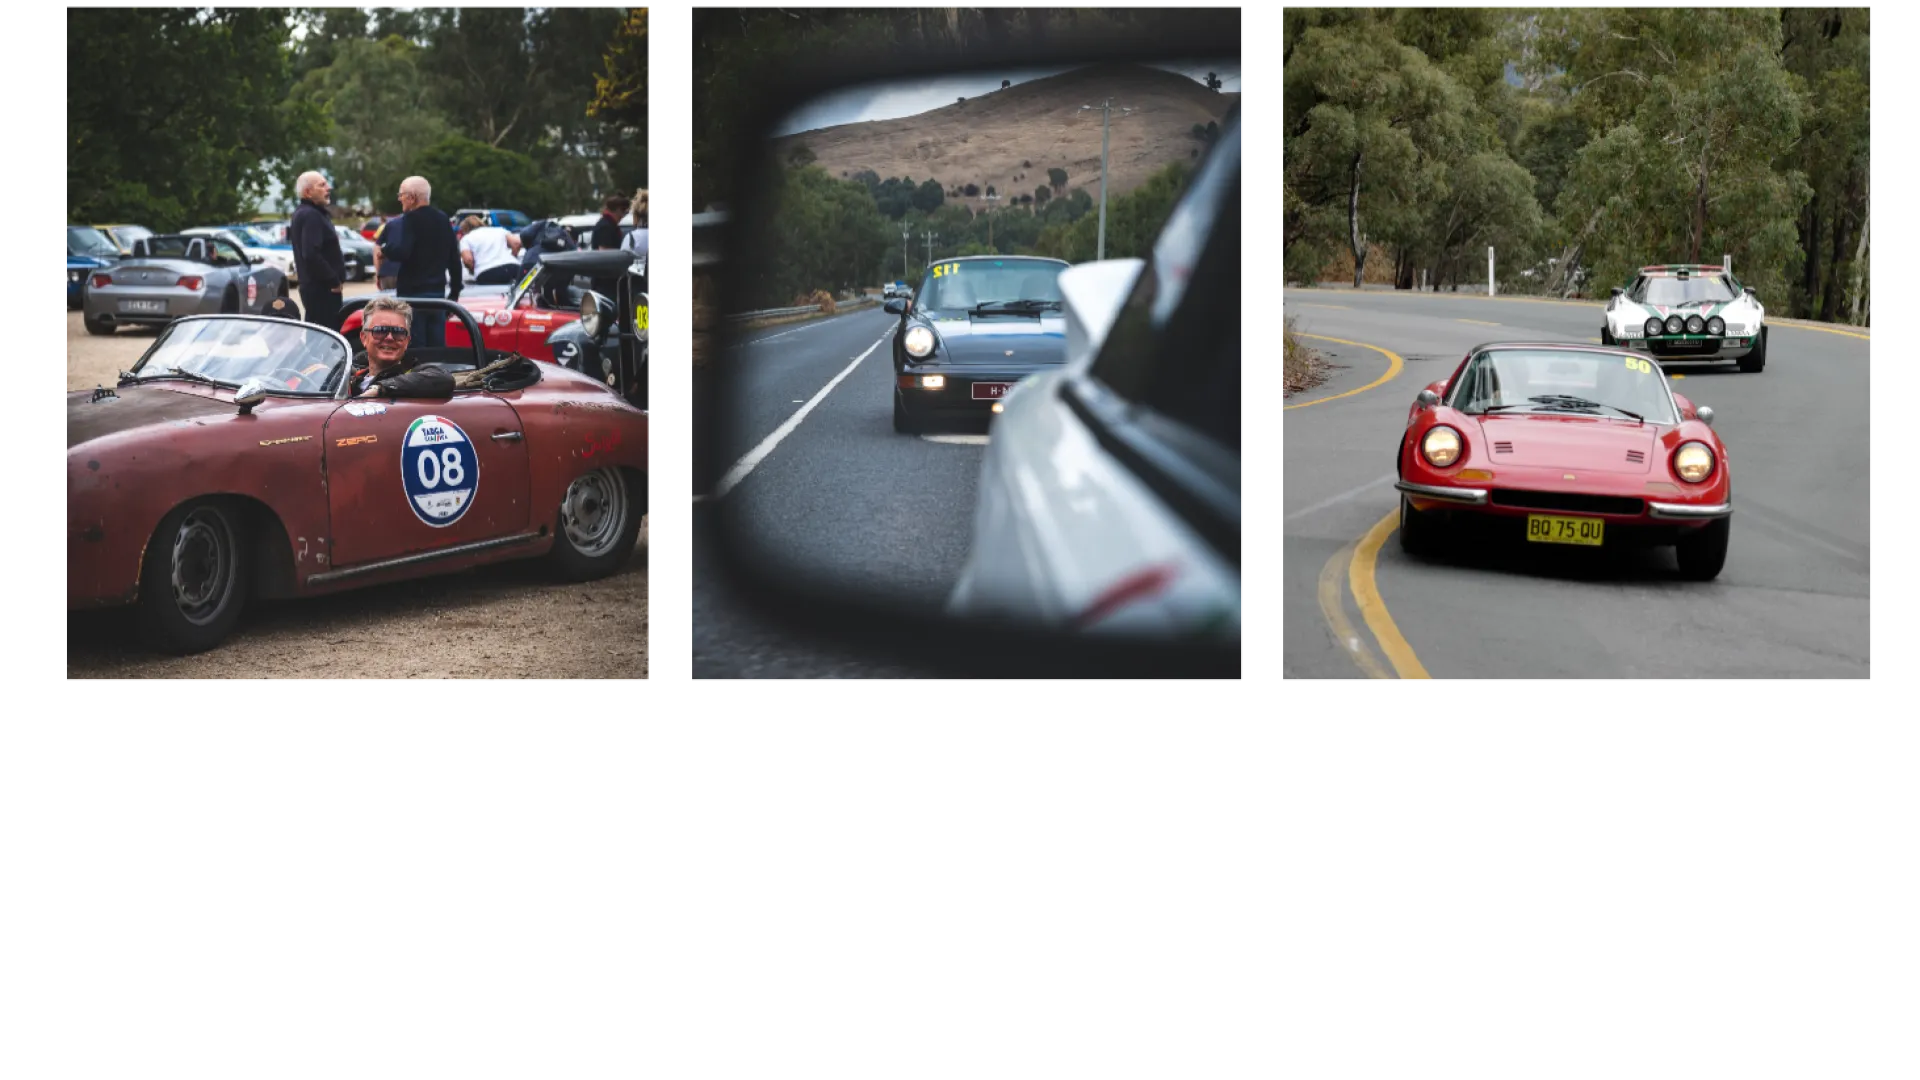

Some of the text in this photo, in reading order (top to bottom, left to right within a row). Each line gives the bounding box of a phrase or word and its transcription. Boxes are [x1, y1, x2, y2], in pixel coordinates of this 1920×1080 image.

[1625, 357, 1651, 373] 50
[421, 427, 445, 436] TARGA
[417, 447, 465, 489] 08
[1556, 520, 1576, 537] 75
